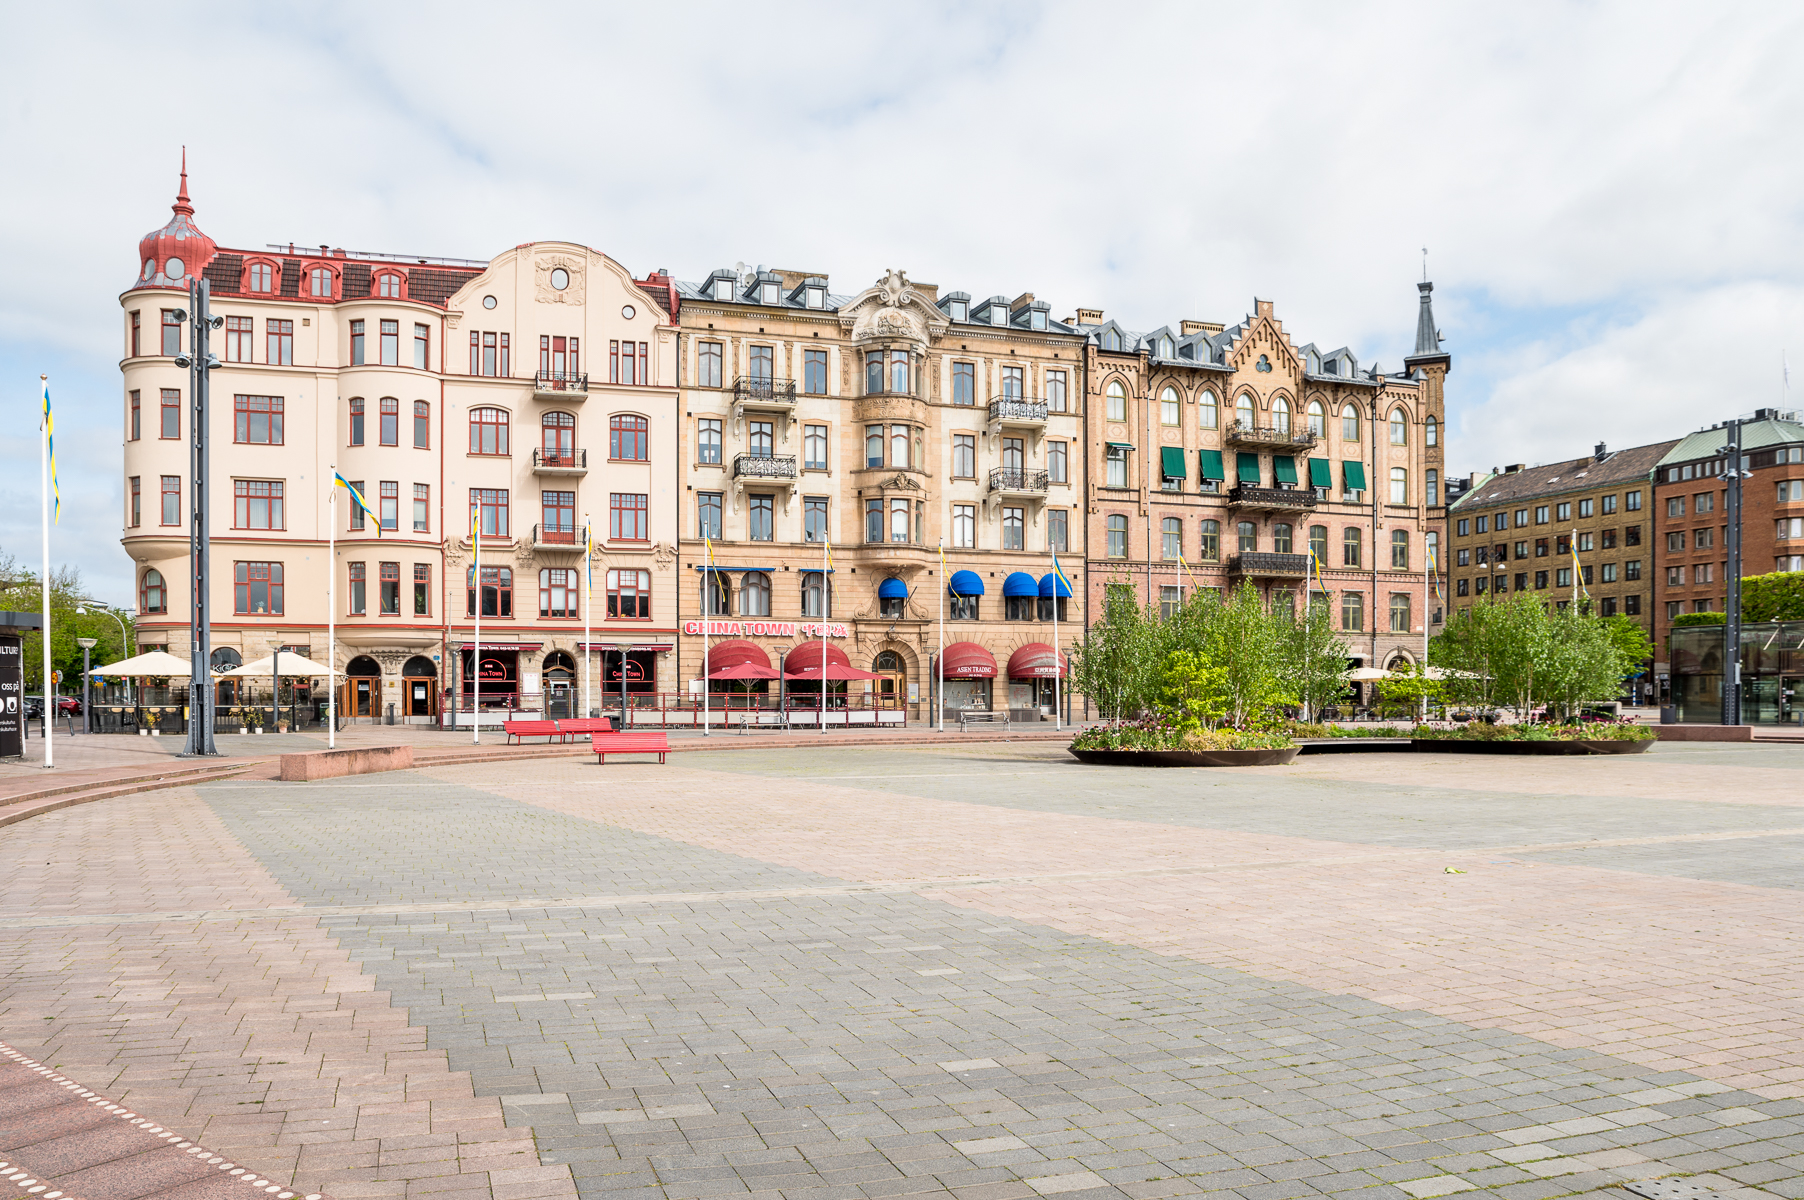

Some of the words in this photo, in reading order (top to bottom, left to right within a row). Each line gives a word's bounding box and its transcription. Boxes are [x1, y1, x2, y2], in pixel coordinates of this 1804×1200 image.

[685, 621, 742, 635] CHINA
[744, 622, 796, 636] TOWN
[972, 666, 992, 674] TRADING
